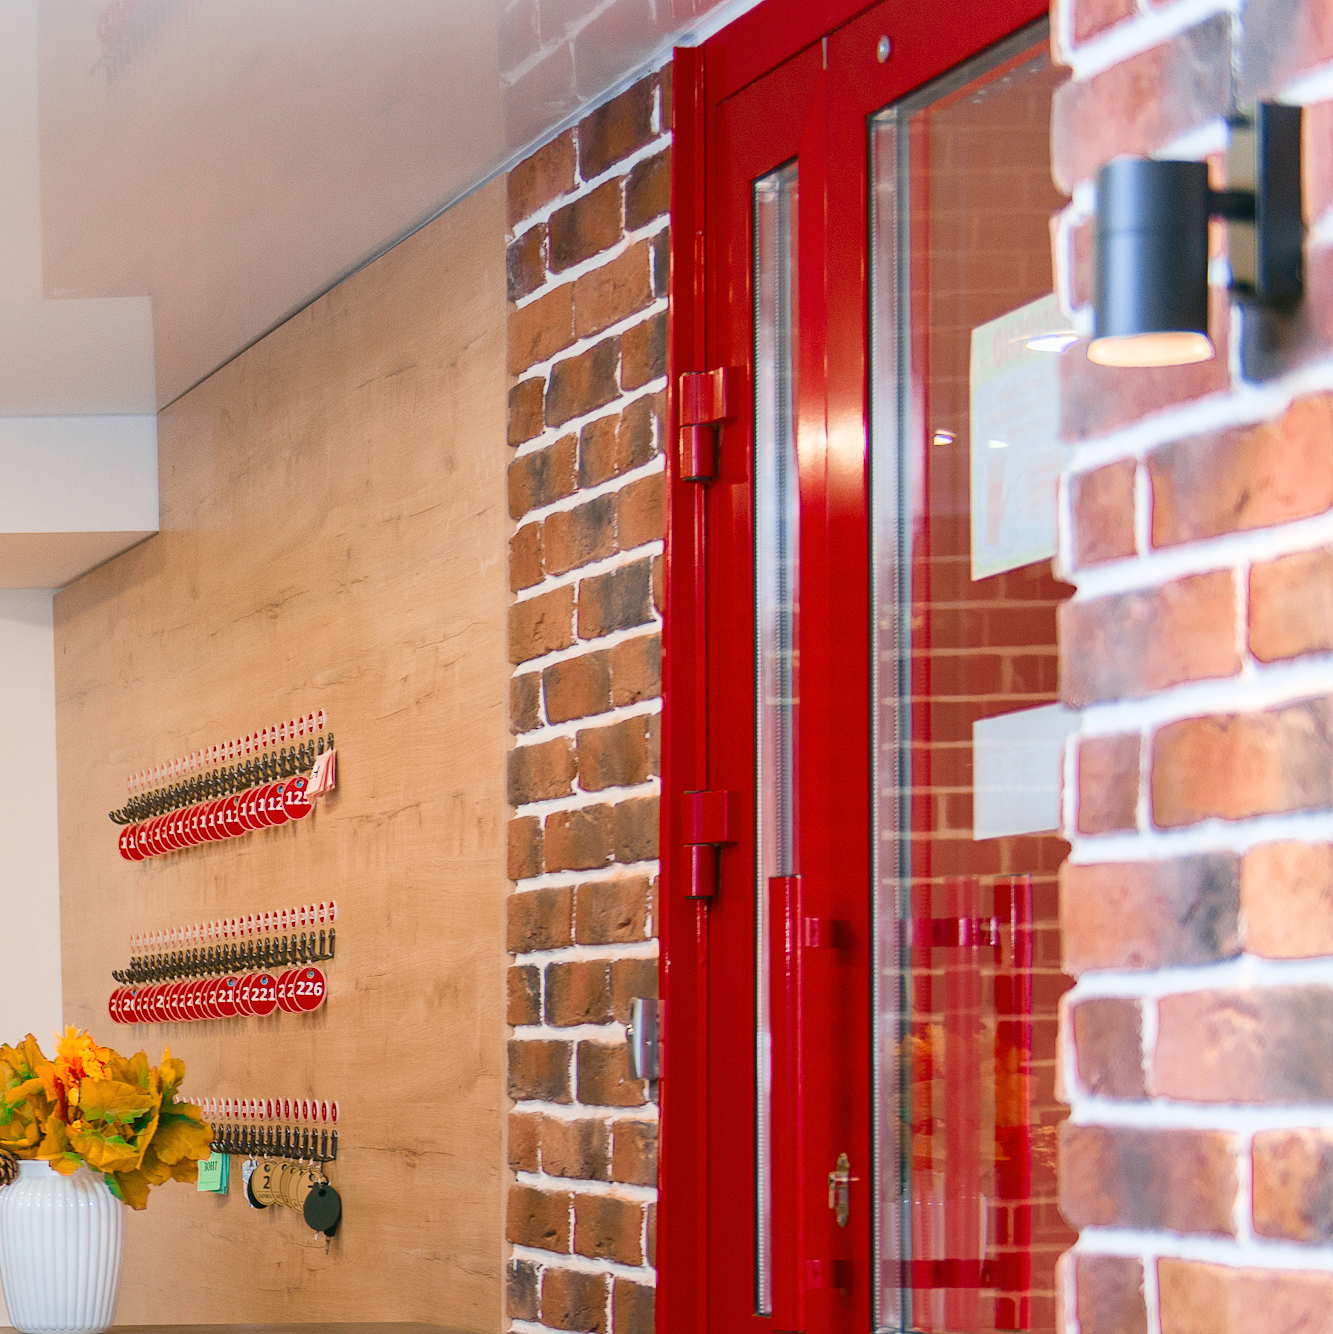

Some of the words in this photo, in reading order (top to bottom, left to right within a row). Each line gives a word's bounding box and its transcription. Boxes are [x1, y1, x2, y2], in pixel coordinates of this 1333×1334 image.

[268, 797, 283, 810] 12
[218, 989, 234, 1003] 21
[251, 987, 276, 1001] 221
[296, 980, 323, 996] 226
